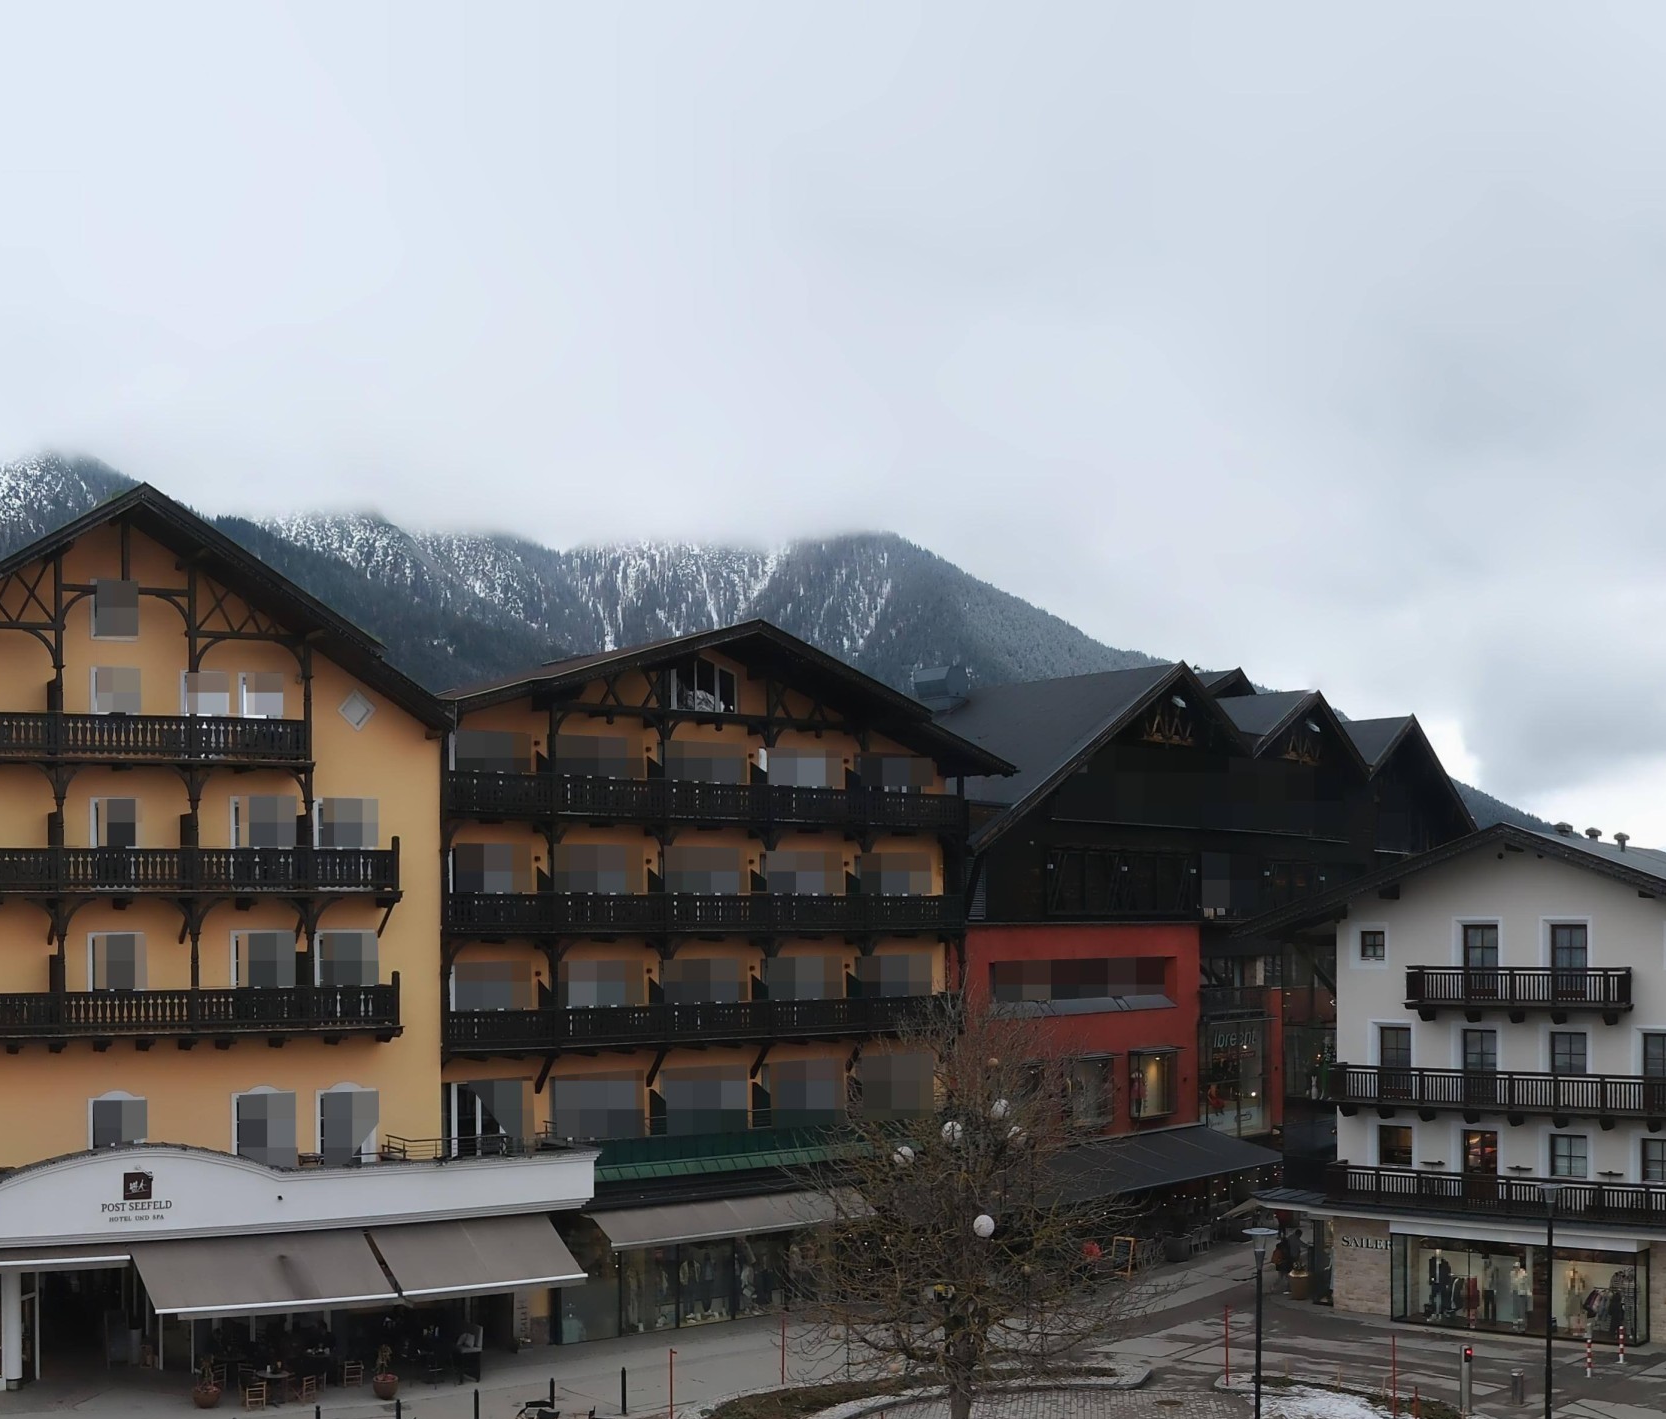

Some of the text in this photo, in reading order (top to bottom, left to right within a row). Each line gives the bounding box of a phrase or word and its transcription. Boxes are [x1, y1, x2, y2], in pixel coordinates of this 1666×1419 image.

[101, 1200, 173, 1213] POST SEEFELD
[108, 1215, 132, 1223] HOTEL
